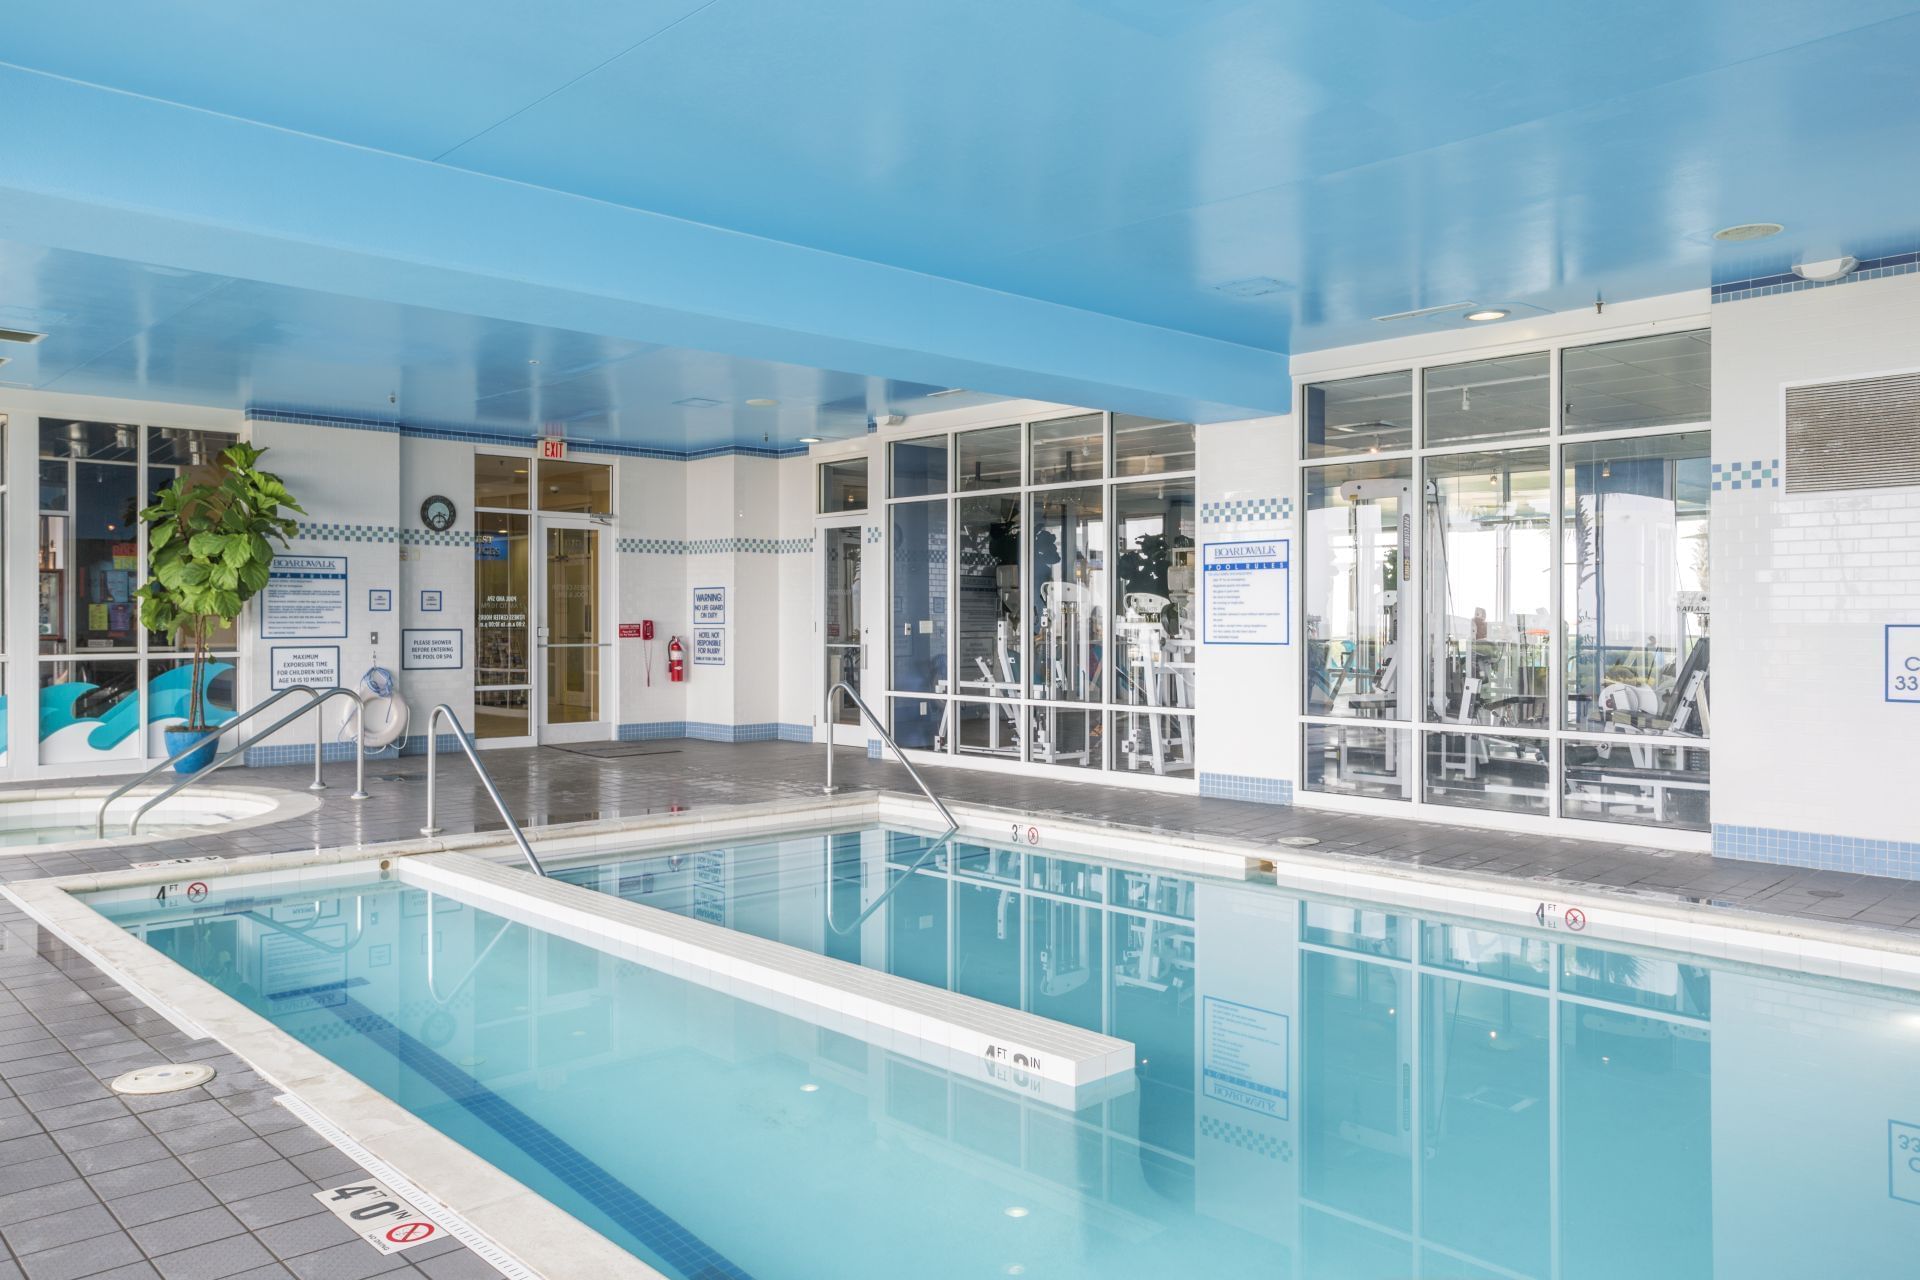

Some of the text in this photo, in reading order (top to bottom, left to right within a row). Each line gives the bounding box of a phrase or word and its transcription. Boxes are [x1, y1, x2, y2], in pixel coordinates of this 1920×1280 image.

[544, 441, 564, 458] EXIT
[1214, 545, 1276, 557] BOARDWALK
[273, 559, 336, 568] BOARDWALK
[1245, 562, 1284, 570] RULES
[1895, 675, 1918, 690] 33
[169, 883, 178, 892] FT
[1547, 903, 1557, 912] FT
[997, 1047, 1008, 1060] FT
[1030, 1056, 1041, 1070] IN
[331, 1186, 388, 1202] 4 FT
